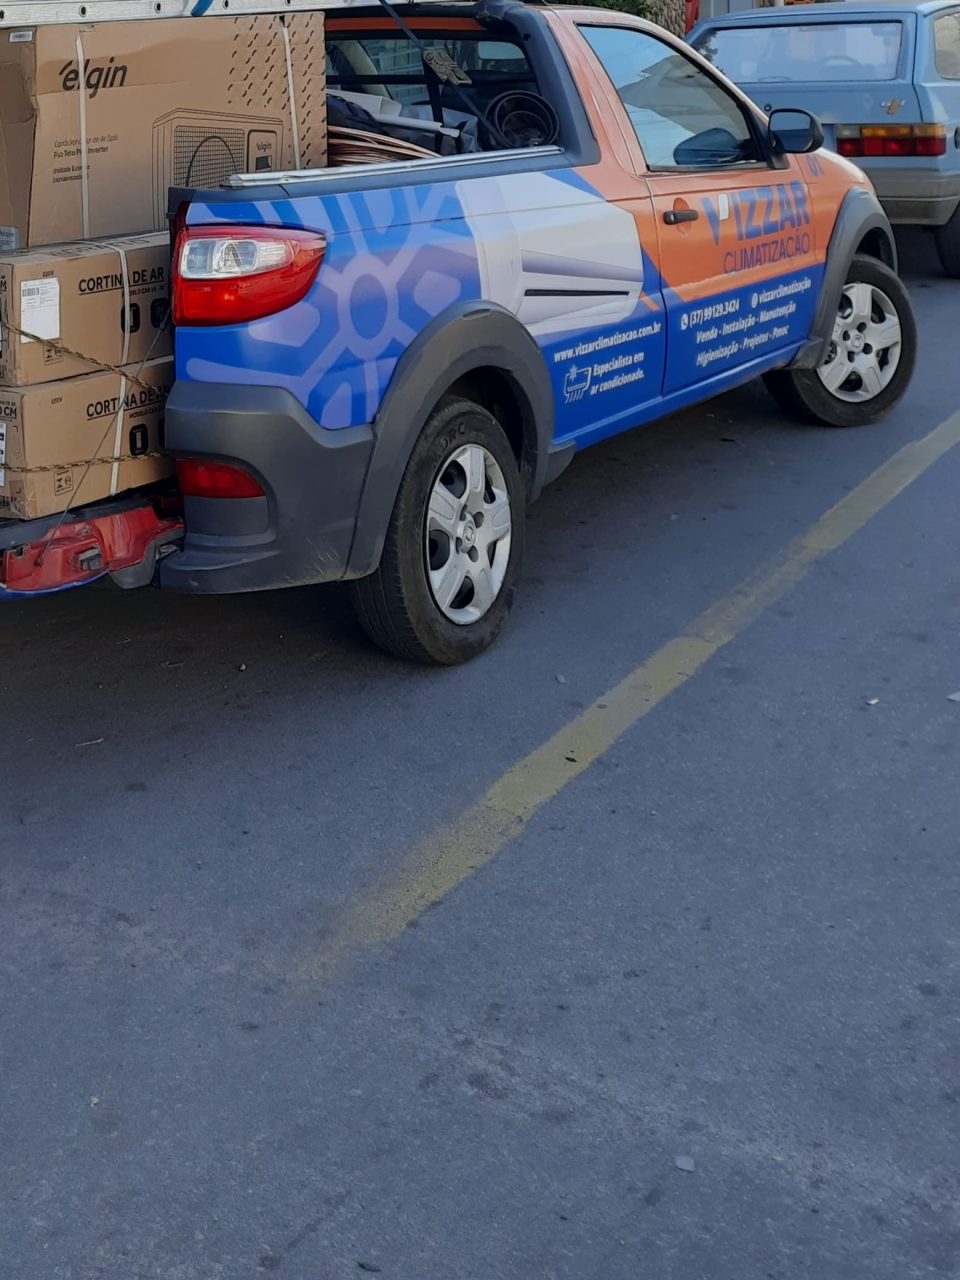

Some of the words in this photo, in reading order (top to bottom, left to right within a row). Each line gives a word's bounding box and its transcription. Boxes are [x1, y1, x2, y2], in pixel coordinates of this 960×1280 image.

[701, 180, 810, 247] VIZZAR
[133, 270, 147, 283] DE
[149, 267, 164, 282] AR
[689, 310, 703, 328] (37)
[696, 326, 718, 344] Venda
[723, 314, 756, 336] Instalação
[760, 301, 796, 323] Manutenção
[554, 321, 661, 362] www.vizzarclimatizacao.com.br
[696, 341, 738, 367] Higienização
[743, 333, 769, 351] Projetos
[593, 356, 633, 377] Especialista
[634, 352, 644, 362] em
[590, 385, 599, 395] ar
[3, 406, 17, 418] CM
